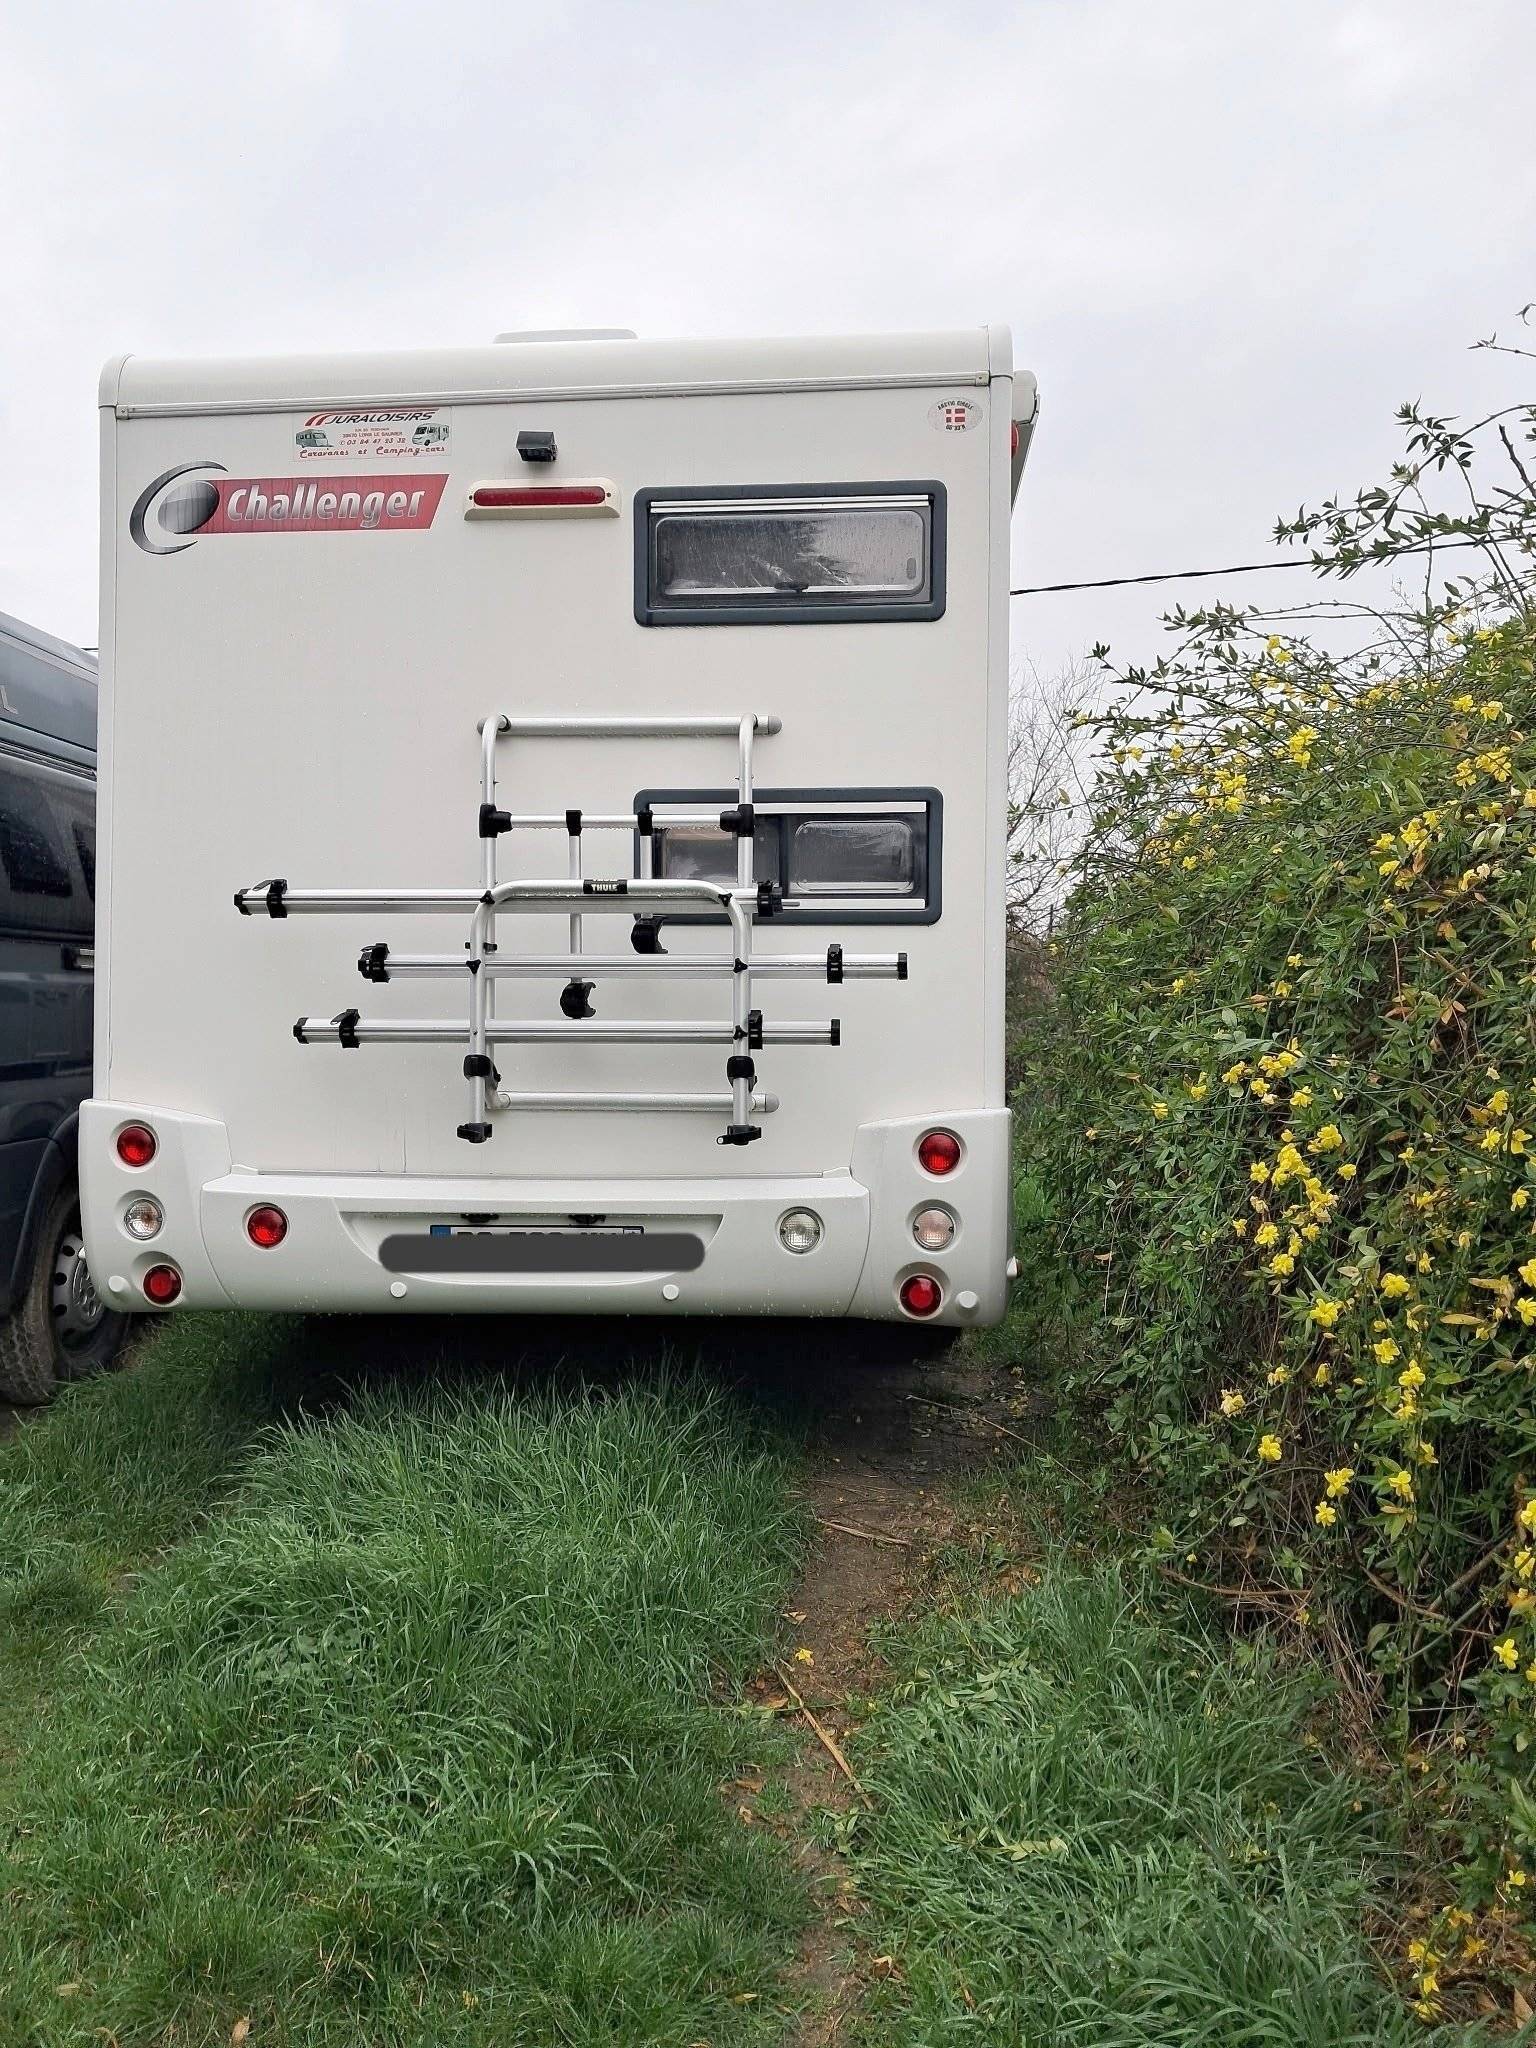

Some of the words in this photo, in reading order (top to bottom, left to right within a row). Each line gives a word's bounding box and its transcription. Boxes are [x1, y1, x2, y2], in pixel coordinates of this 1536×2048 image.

[325, 411, 435, 424] JURALOISIRS
[299, 449, 349, 458] Caravanes
[227, 483, 425, 528] Challenger
